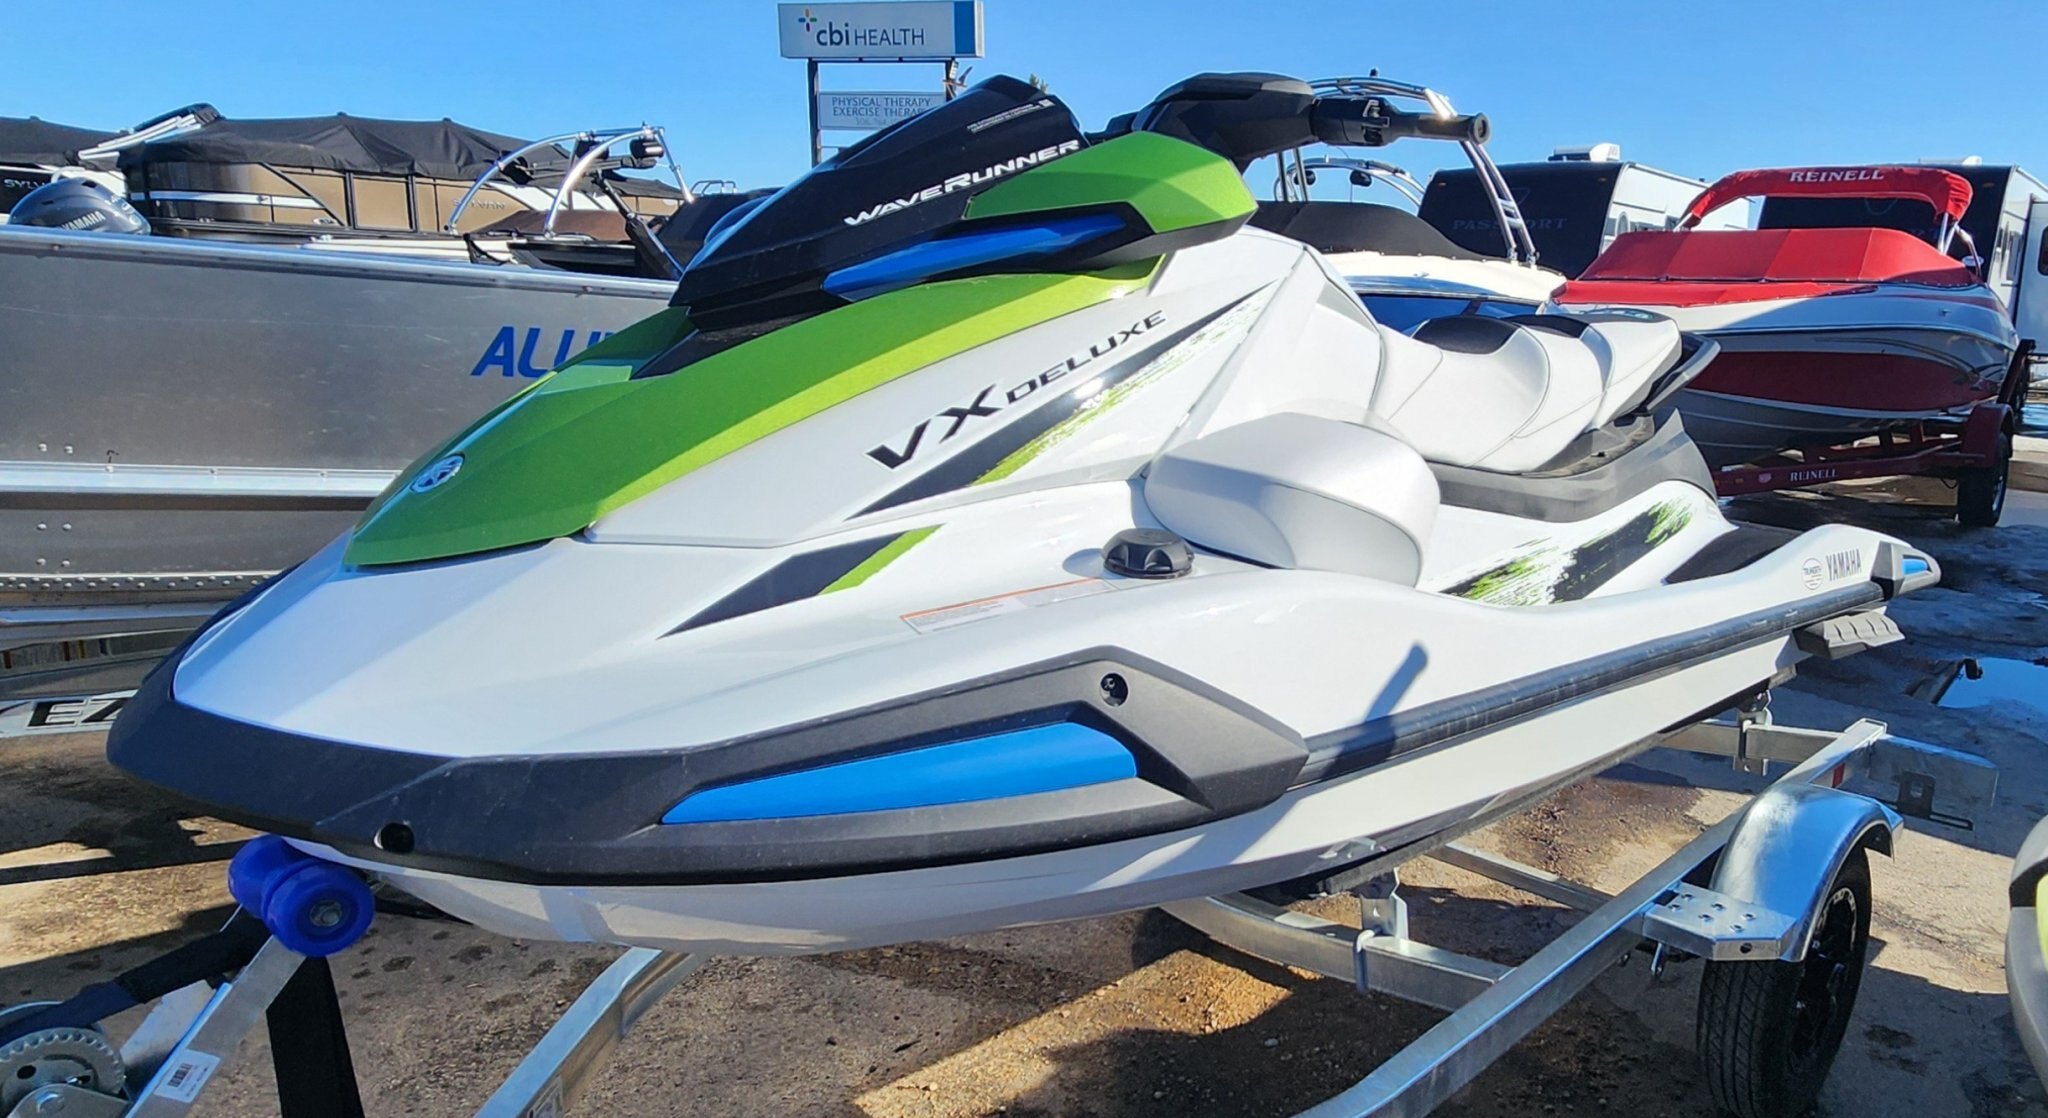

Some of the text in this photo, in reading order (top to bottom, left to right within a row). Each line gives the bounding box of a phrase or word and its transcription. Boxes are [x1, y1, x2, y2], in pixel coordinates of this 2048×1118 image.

[816, 22, 925, 46] cbi HEALTH
[832, 97, 930, 107] PHYSICAL THERAPY
[833, 107, 880, 117] EXERCISE
[1790, 169, 1885, 182] REINELL
[62, 211, 106, 230] YAMAHA
[866, 310, 1167, 469] VX DELUXE
[1790, 468, 1838, 482] REINELL
[1825, 549, 1862, 581] YAMAHA
